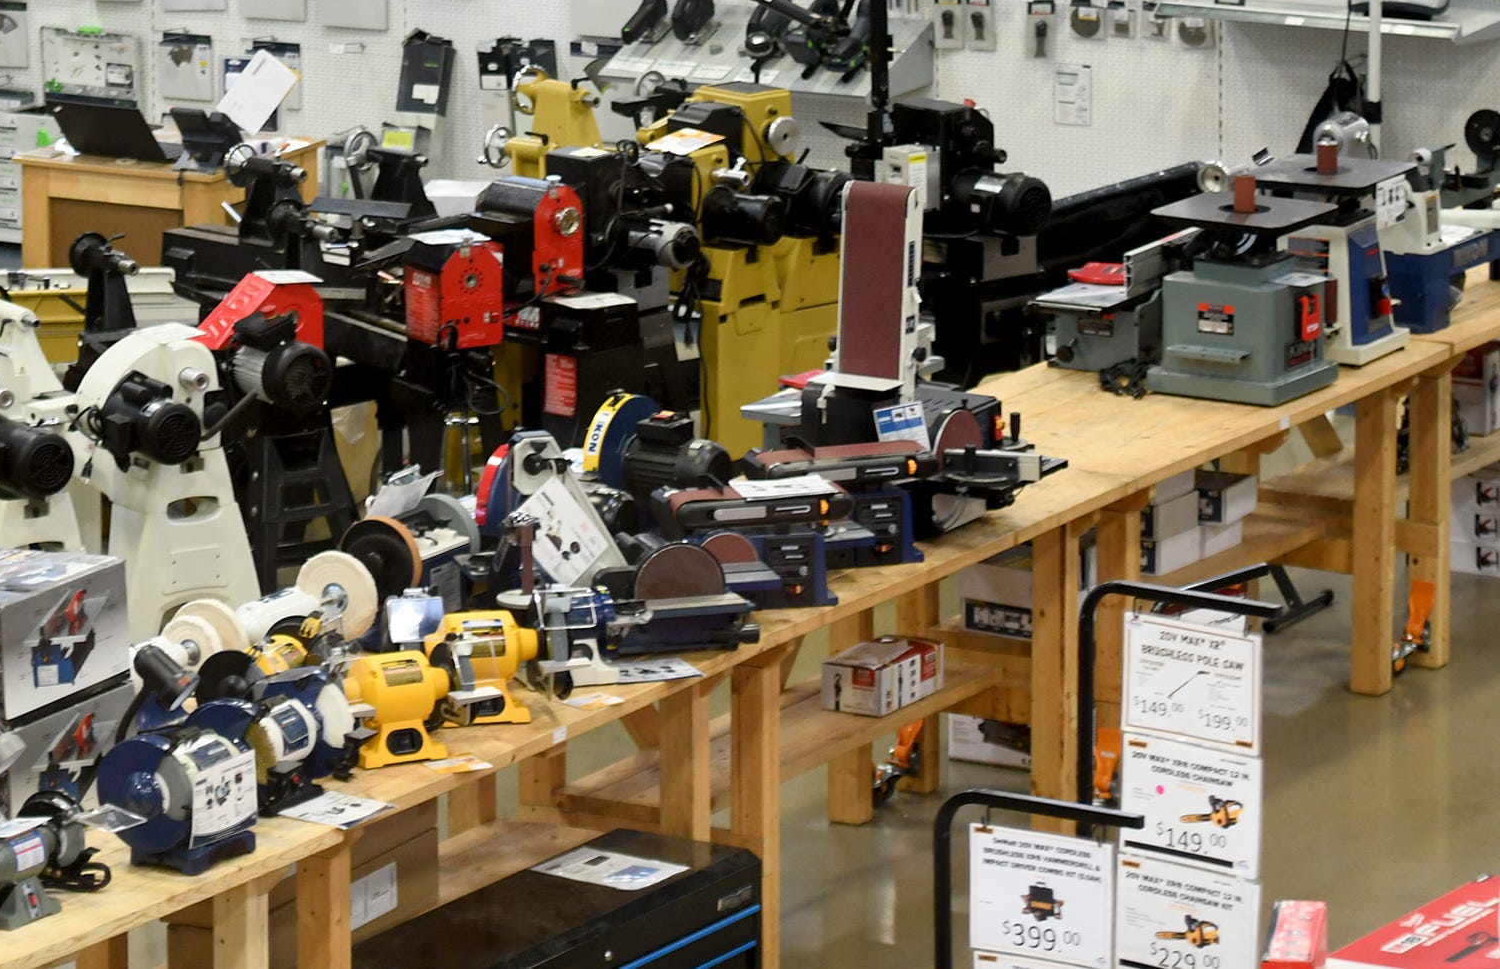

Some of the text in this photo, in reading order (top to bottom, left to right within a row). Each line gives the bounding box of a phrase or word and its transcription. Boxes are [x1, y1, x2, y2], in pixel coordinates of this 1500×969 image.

[1155, 821, 1227, 855] $149.00
[1001, 920, 1081, 953] $399.00
[1149, 941, 1221, 969] $22900
